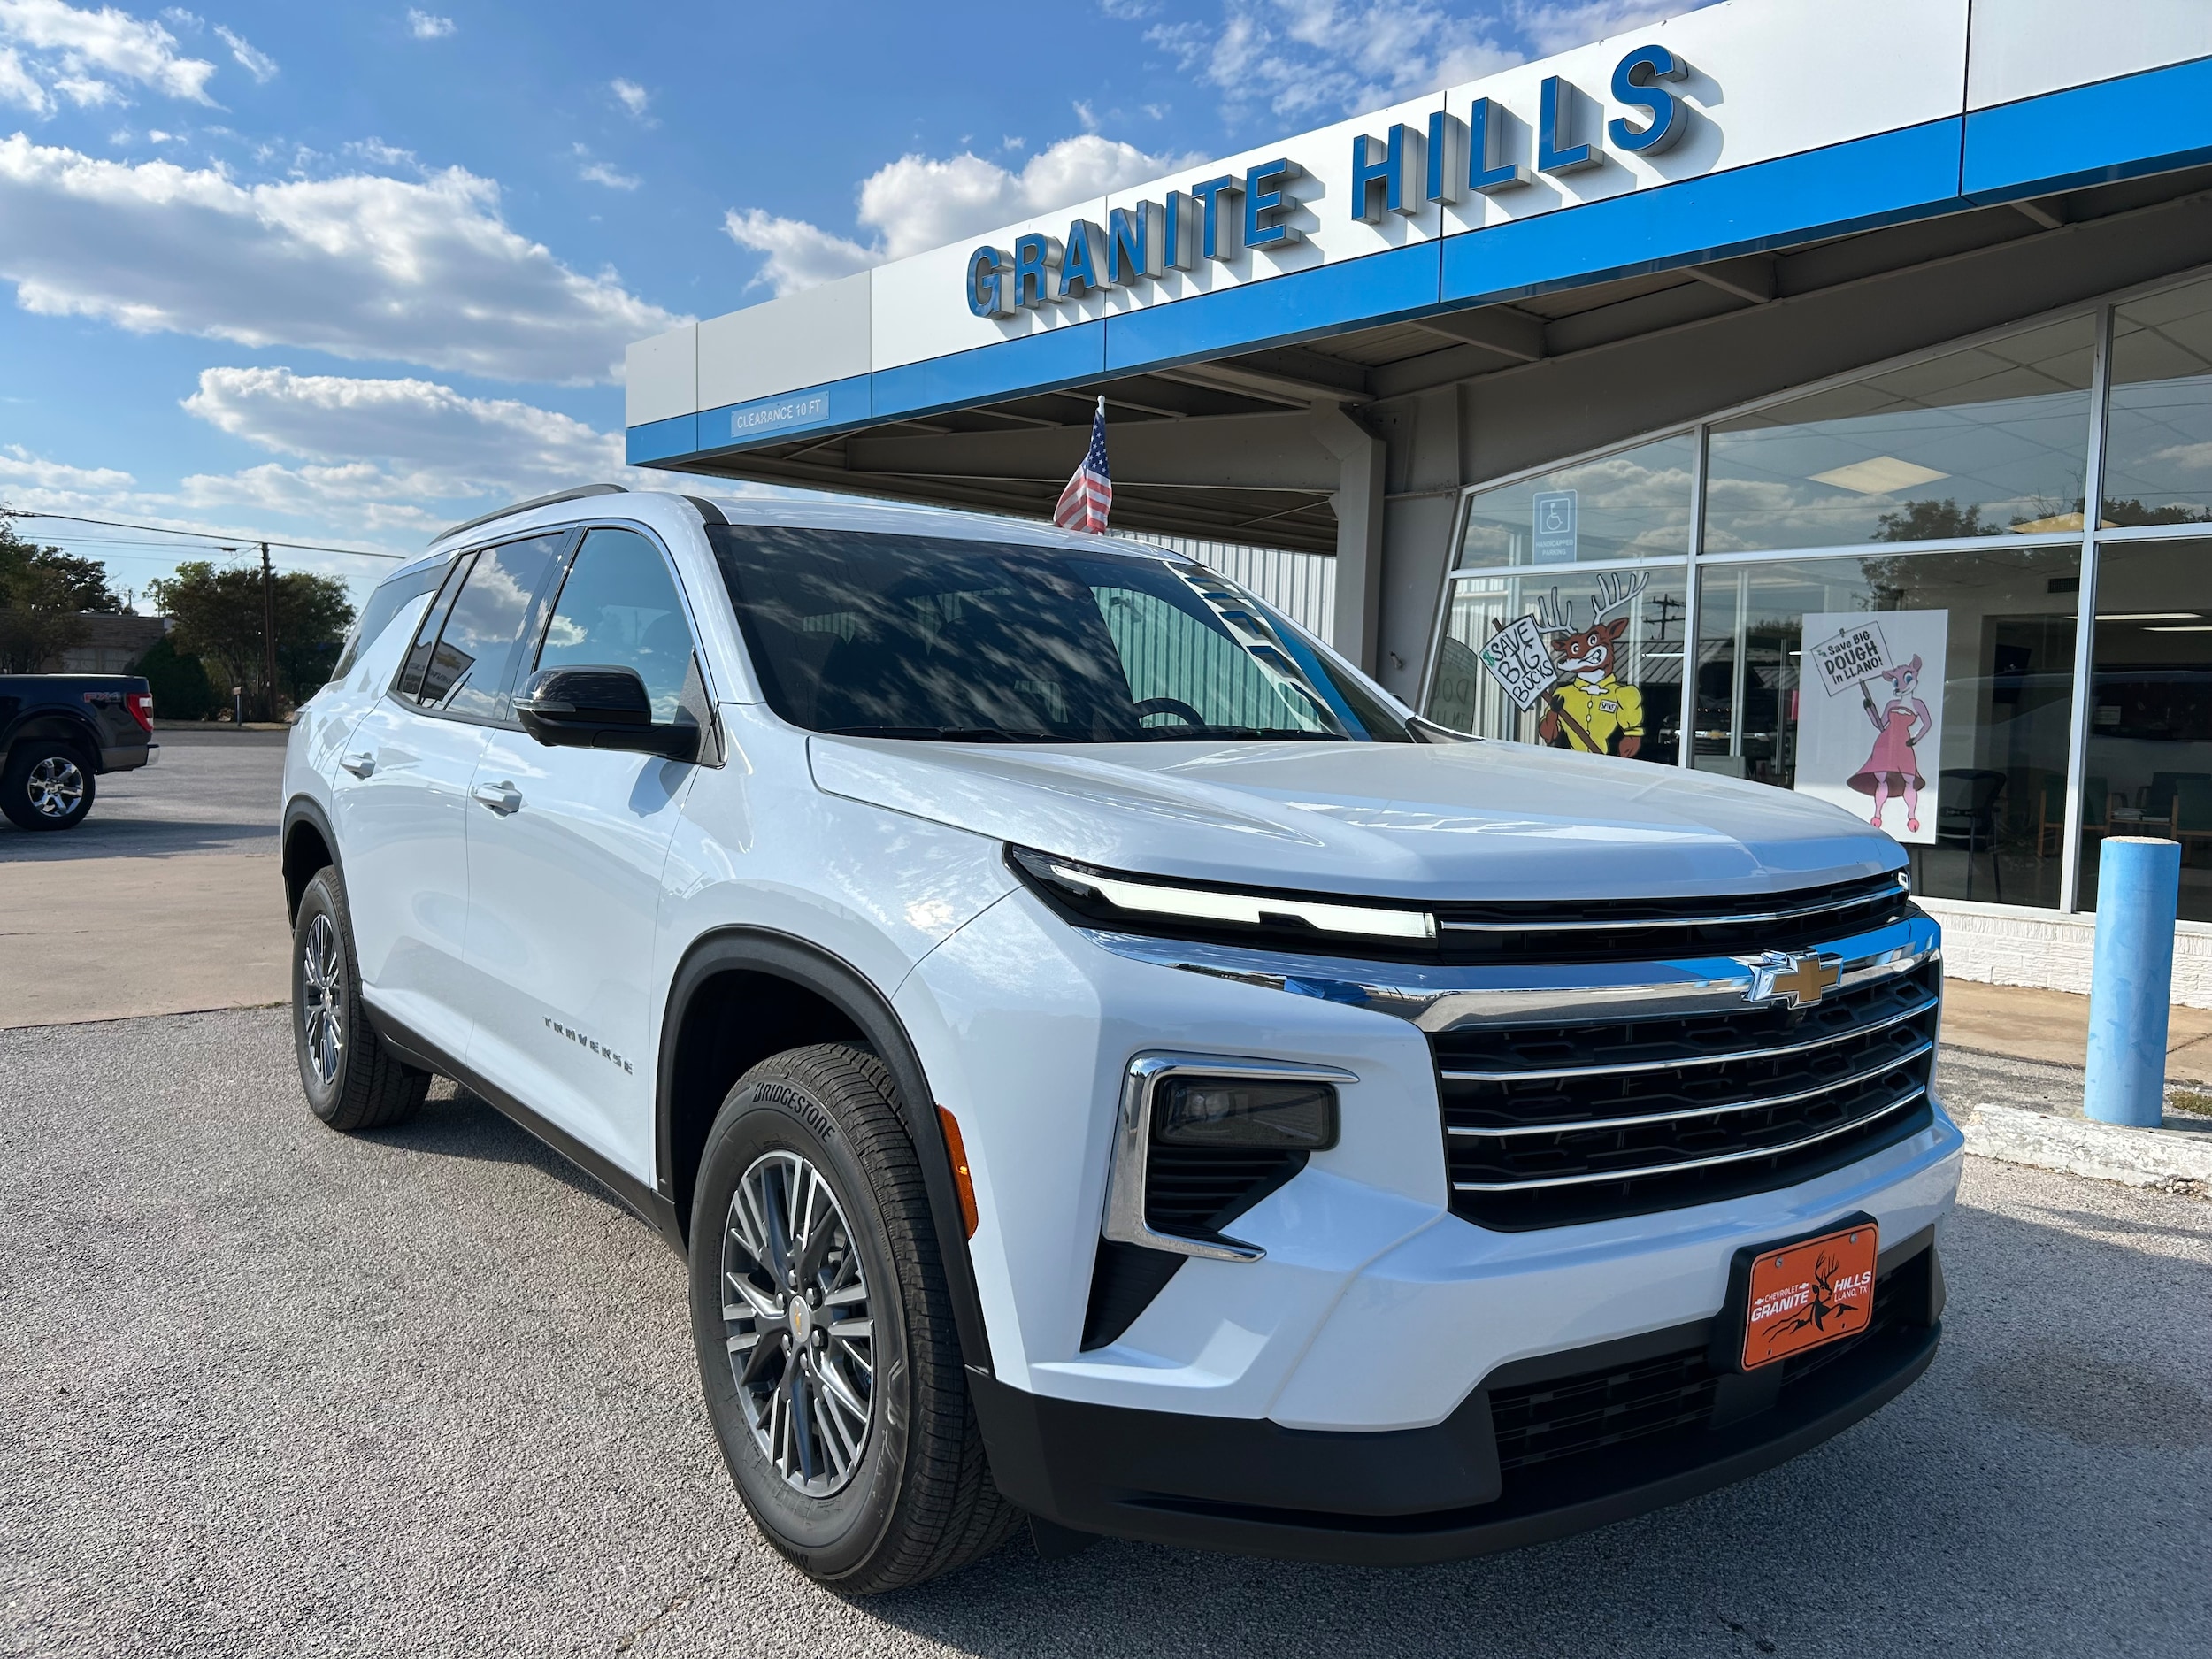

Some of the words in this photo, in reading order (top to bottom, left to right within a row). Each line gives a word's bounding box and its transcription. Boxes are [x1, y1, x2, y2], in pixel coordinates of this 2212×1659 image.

[966, 158, 1300, 320] GRANITE
[1352, 44, 1688, 225] HILLS
[737, 405, 794, 429] CLEARANCE
[796, 403, 807, 418] 10
[809, 399, 821, 414] FT
[1542, 548, 1566, 557] PARKING
[1824, 640, 1878, 675] DOUGH
[1828, 641, 1852, 656] Save
[1852, 630, 1870, 645] BIG
[1498, 644, 1540, 684] BIG
[1844, 656, 1883, 680] LLANO!
[83, 692, 121, 703] FX4
[1513, 660, 1554, 703] BUCKS
[542, 1015, 634, 1076] TRAVERSE
[753, 1081, 836, 1144] BRIDGESTONE
[1751, 1290, 1810, 1323] GRANITE
[1833, 1271, 1872, 1294] HILLS
[1764, 1284, 1799, 1302] CHEVROLET
[1858, 1285, 1869, 1294] TX
